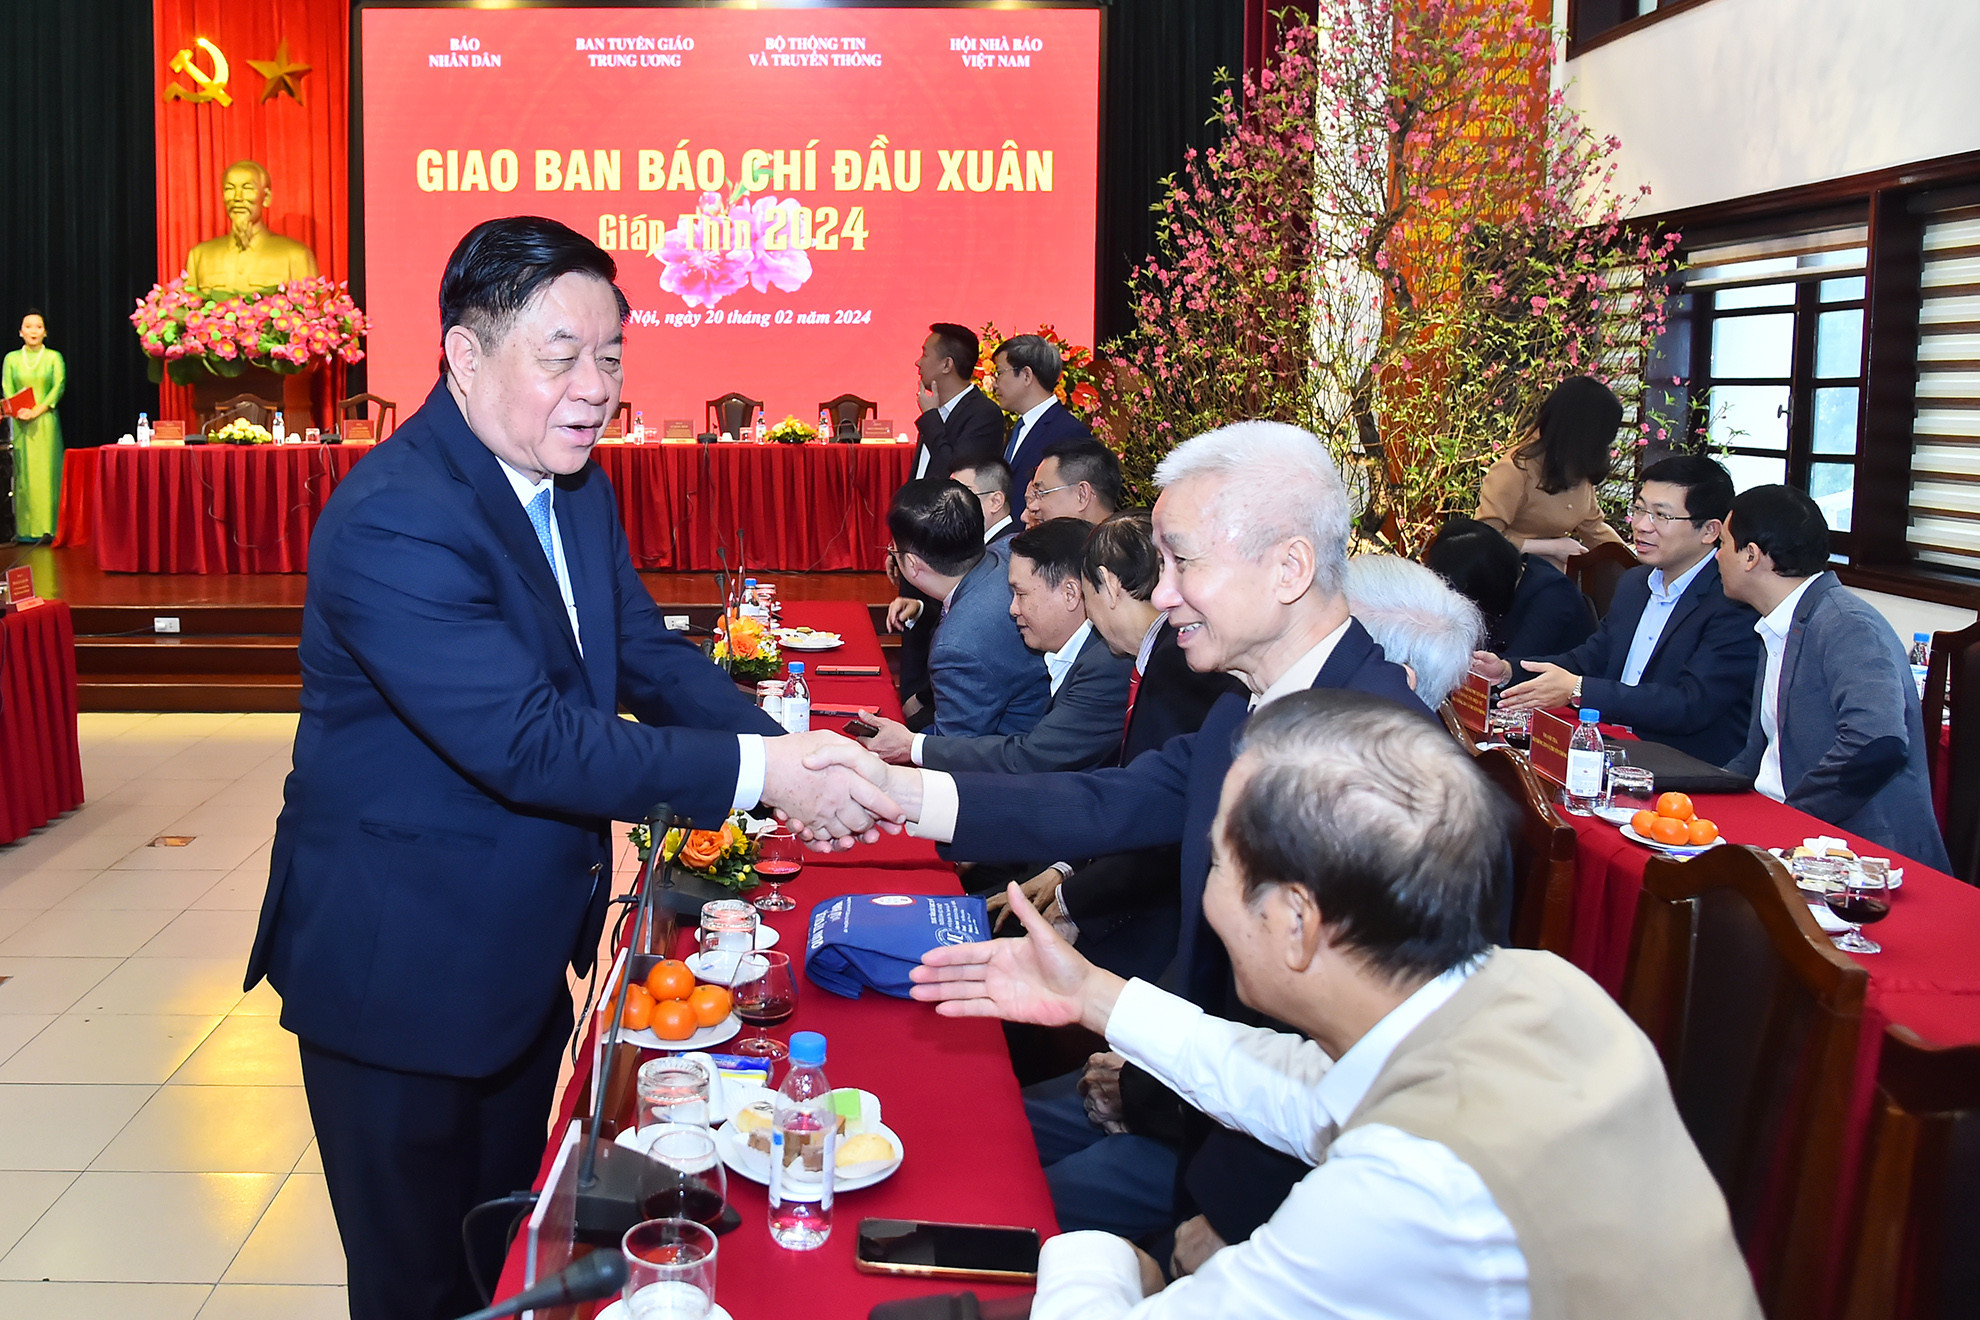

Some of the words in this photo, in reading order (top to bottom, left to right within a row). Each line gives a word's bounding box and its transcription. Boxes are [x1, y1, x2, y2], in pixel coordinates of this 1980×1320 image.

[449, 35, 481, 51] BÁO
[575, 37, 605, 51] BAN
[607, 35, 655, 51] TUYÊN
[657, 35, 695, 51] GIÁO
[765, 34, 786, 53] BỘ
[788, 34, 839, 51] THÔNG
[841, 37, 866, 51] TIN
[949, 35, 977, 53] HỘI
[979, 35, 1010, 51] NHÀ
[1012, 35, 1043, 52] BÁO
[428, 52, 469, 68] NHÂN
[471, 52, 501, 68] DÂN
[587, 54, 638, 68] TRUNG
[748, 51, 769, 67] VÀ
[830, 51, 882, 67] THÔNG
[961, 53, 995, 70] VIỆT
[997, 54, 1031, 68] NAM
[416, 148, 519, 192] GIAO
[534, 149, 621, 191] BAN
[638, 139, 726, 192] BÁO
[741, 139, 820, 192] CHÍ
[831, 134, 921, 192] ĐẦU
[936, 139, 1053, 192] XUÂN
[598, 213, 666, 258] Giáp
[764, 206, 870, 251] 2024
[664, 310, 702, 328] ngày
[704, 309, 724, 324] 20
[726, 309, 772, 328] tháng
[774, 309, 794, 324] 02
[796, 310, 831, 325] năm
[833, 309, 872, 325] 2024
